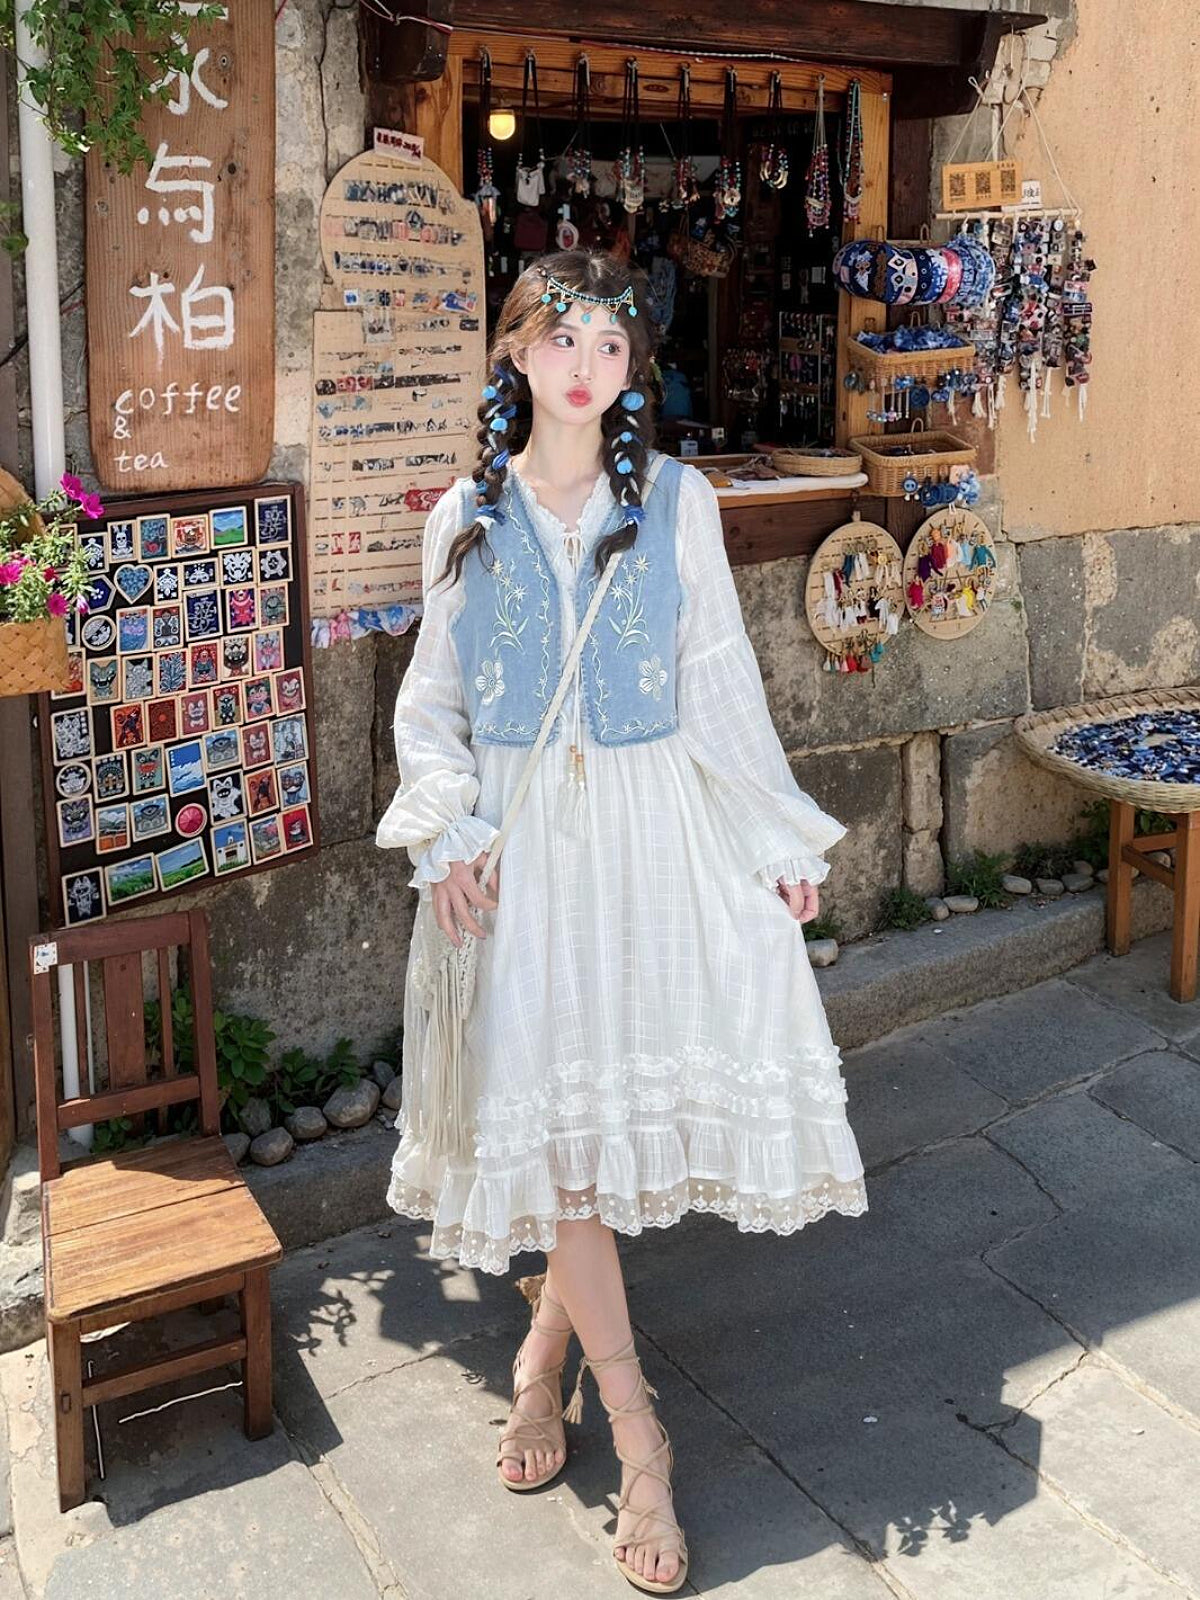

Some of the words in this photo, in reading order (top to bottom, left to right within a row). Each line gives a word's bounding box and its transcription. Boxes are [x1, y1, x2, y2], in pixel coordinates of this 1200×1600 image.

[114, 382, 241, 415] coffee
[113, 415, 132, 439] &
[113, 450, 169, 472] tea
